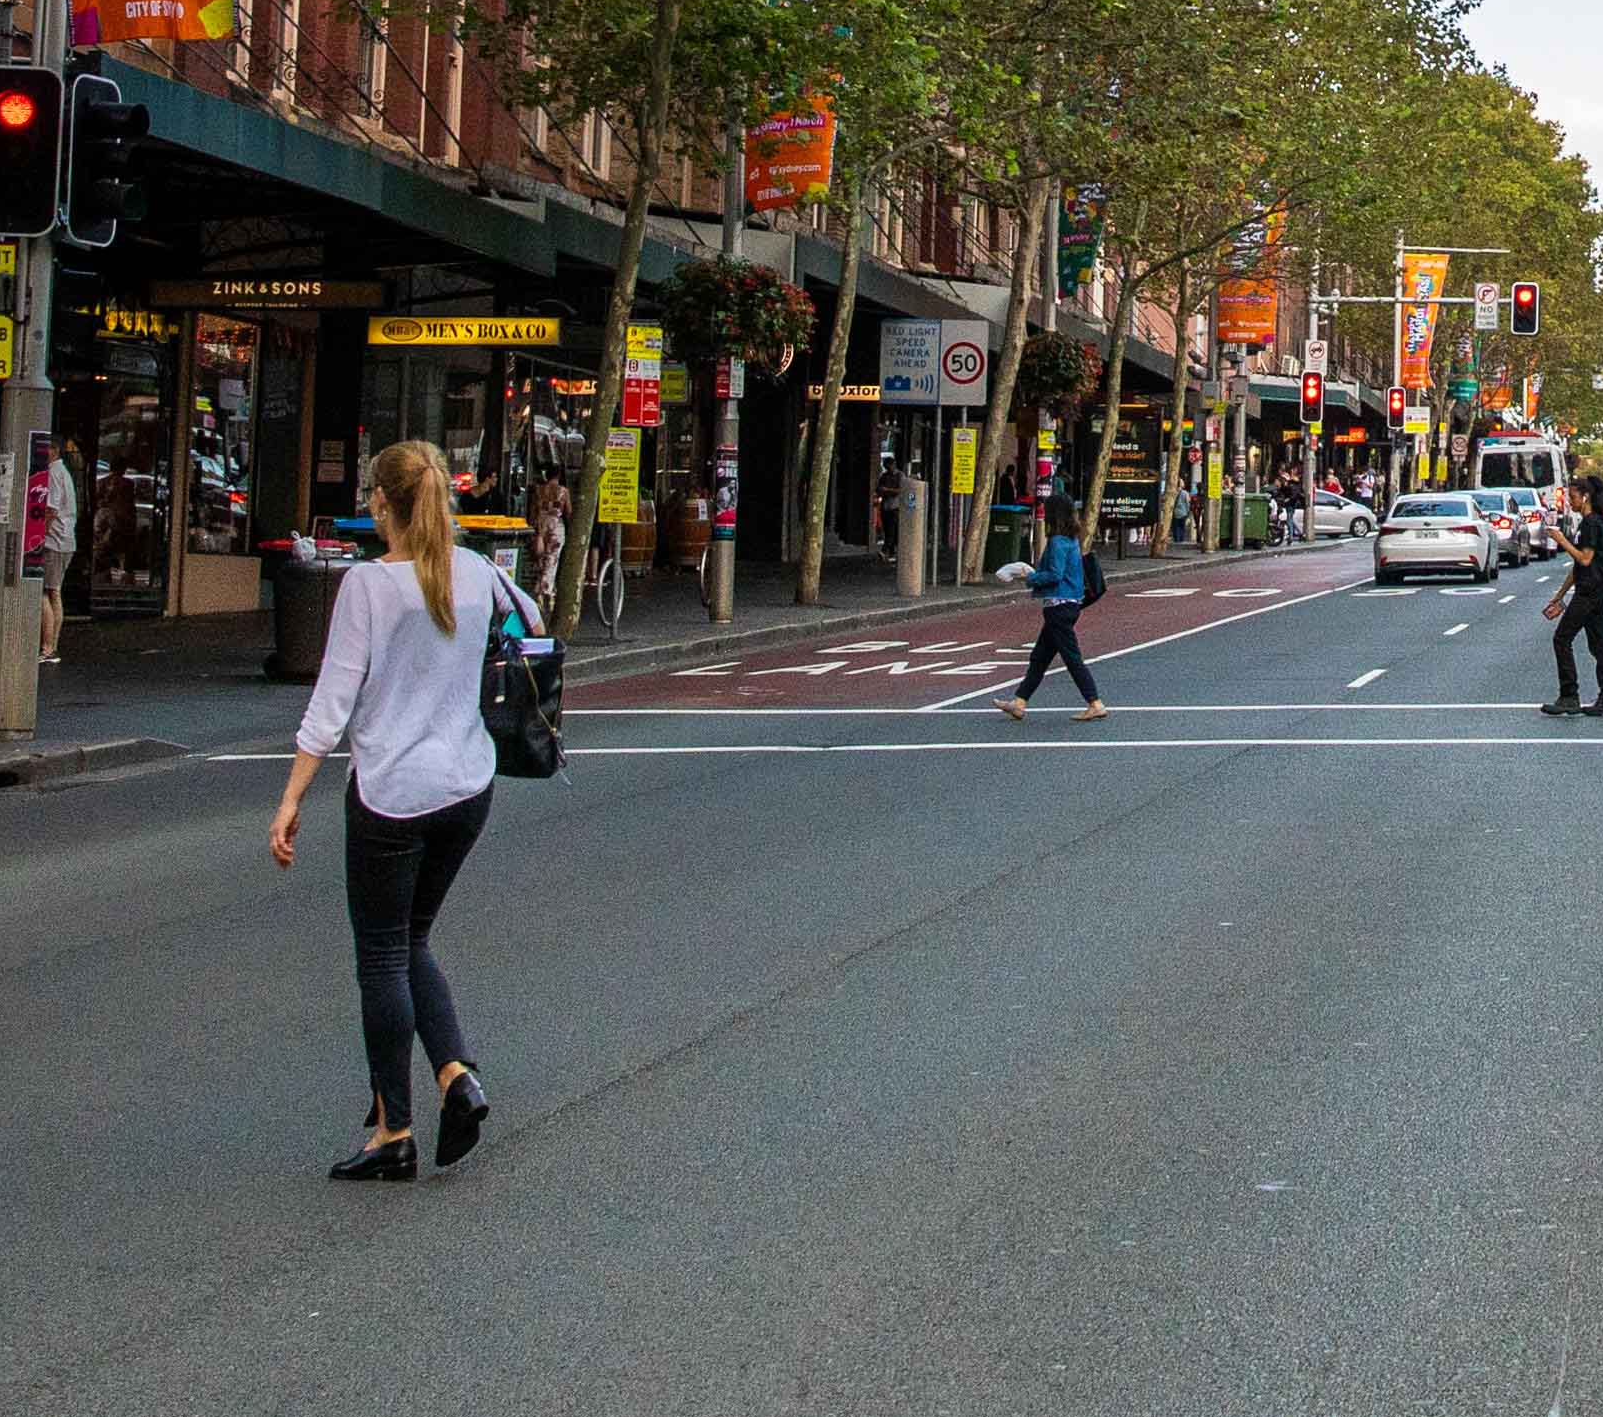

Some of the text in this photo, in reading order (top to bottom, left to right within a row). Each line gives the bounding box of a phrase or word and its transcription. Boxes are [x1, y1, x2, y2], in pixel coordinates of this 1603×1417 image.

[212, 281, 255, 295] ZINK
[271, 281, 322, 296] SONS
[1479, 305, 1493, 313] NO
[425, 323, 474, 339] MEN'S
[477, 323, 510, 339] BOX
[525, 323, 547, 339] CO
[908, 326, 937, 335] LIGHT
[895, 337, 926, 347] SPEED
[888, 348, 931, 358] CAMERA
[892, 358, 927, 368] AHEAD
[950, 353, 978, 373] 50
